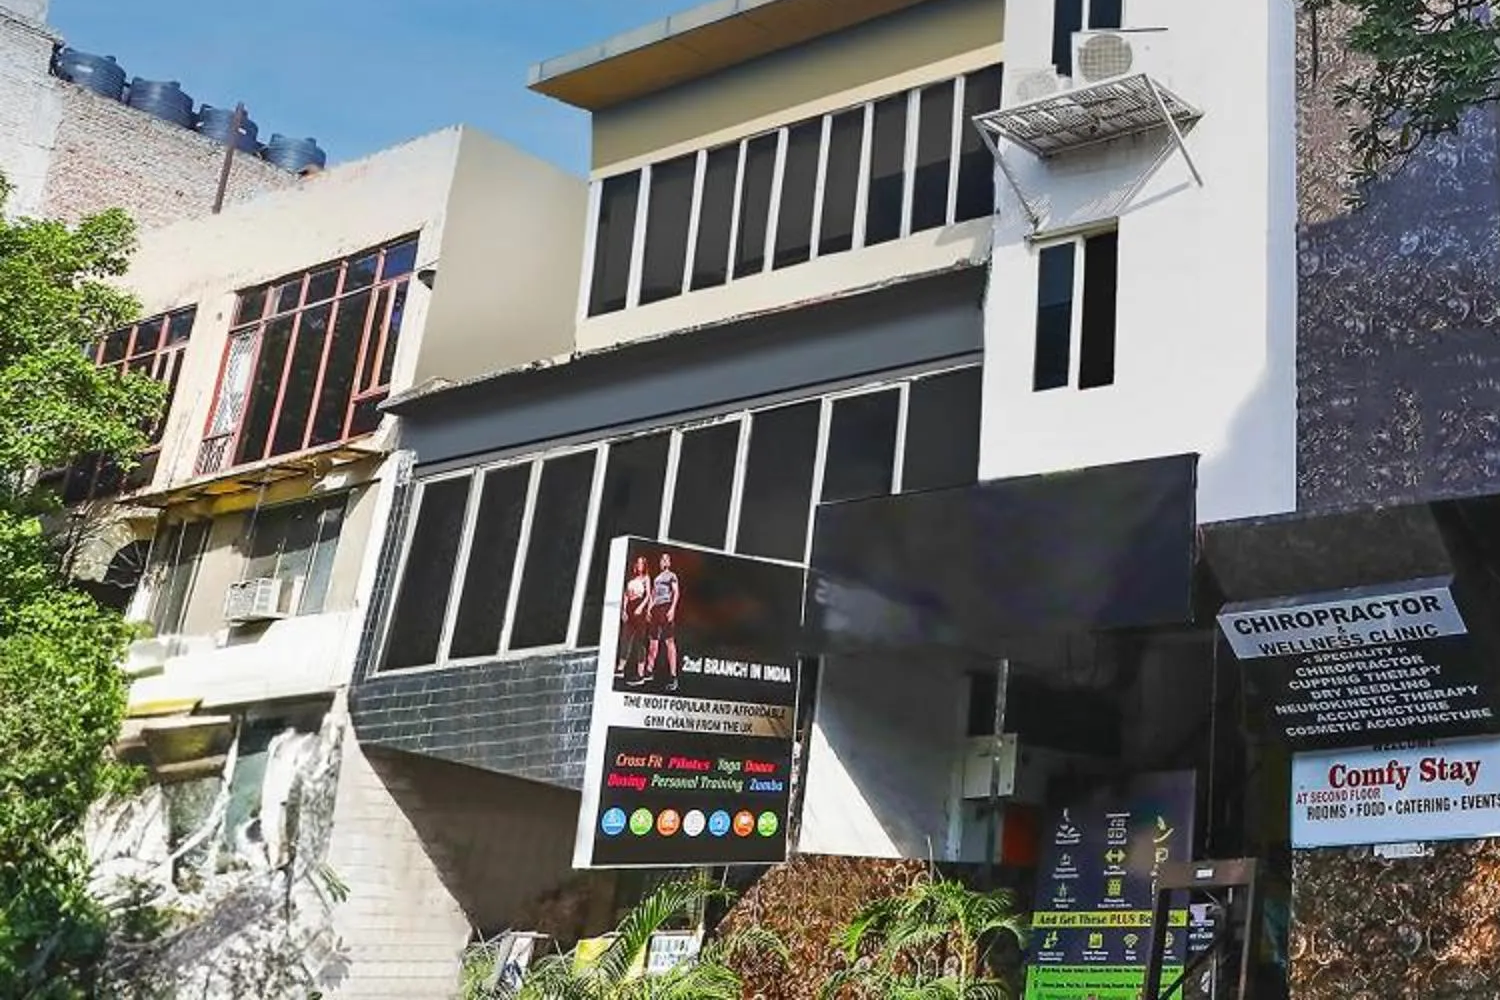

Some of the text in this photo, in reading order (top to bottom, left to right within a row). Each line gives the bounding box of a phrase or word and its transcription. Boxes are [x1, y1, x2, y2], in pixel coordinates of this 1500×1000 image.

[1233, 595, 1444, 635] CHIROPRACTOR
[1258, 623, 1439, 656] WELLNESS CLINIC
[1295, 654, 1425, 677] CHIROPRACTOR
[1315, 646, 1393, 664] SPECIALITY
[682, 655, 791, 683] 2nd BRANCH IN INDIA
[1289, 664, 1442, 690] CUPPING THERAPY
[1275, 685, 1479, 716] NEUROKINETIC THERAPY
[1310, 678, 1431, 701] DRY NEEDLING
[624, 695, 787, 719] THE MOST POPULAR AND AFFORDABLE
[1316, 701, 1450, 723] ACCUPUNCTURE
[643, 715, 664, 728] GYM
[666, 716, 694, 729] CHAIN
[696, 717, 721, 731] FROM
[723, 719, 739, 732] THE
[1286, 708, 1493, 738] COSMETIC ACCUPUNCTURE
[616, 753, 645, 768] Cross
[648, 754, 663, 768] Fit
[668, 755, 711, 771] Pilates
[717, 757, 741, 775] Yoga
[1328, 756, 1481, 790] Comfy Stay
[650, 773, 699, 790] Personal
[700, 776, 744, 792] Training
[749, 778, 783, 791] Zumba
[1296, 787, 1381, 805] AT SECOND FLOOR
[1307, 804, 1347, 821] ROOMS
[1356, 801, 1386, 817] FOOD
[1395, 797, 1451, 815] CATERING
[1039, 914, 1057, 925] And
[1059, 914, 1076, 926] Get
[1079, 914, 1108, 925] These
[1109, 914, 1136, 926] PLUS
